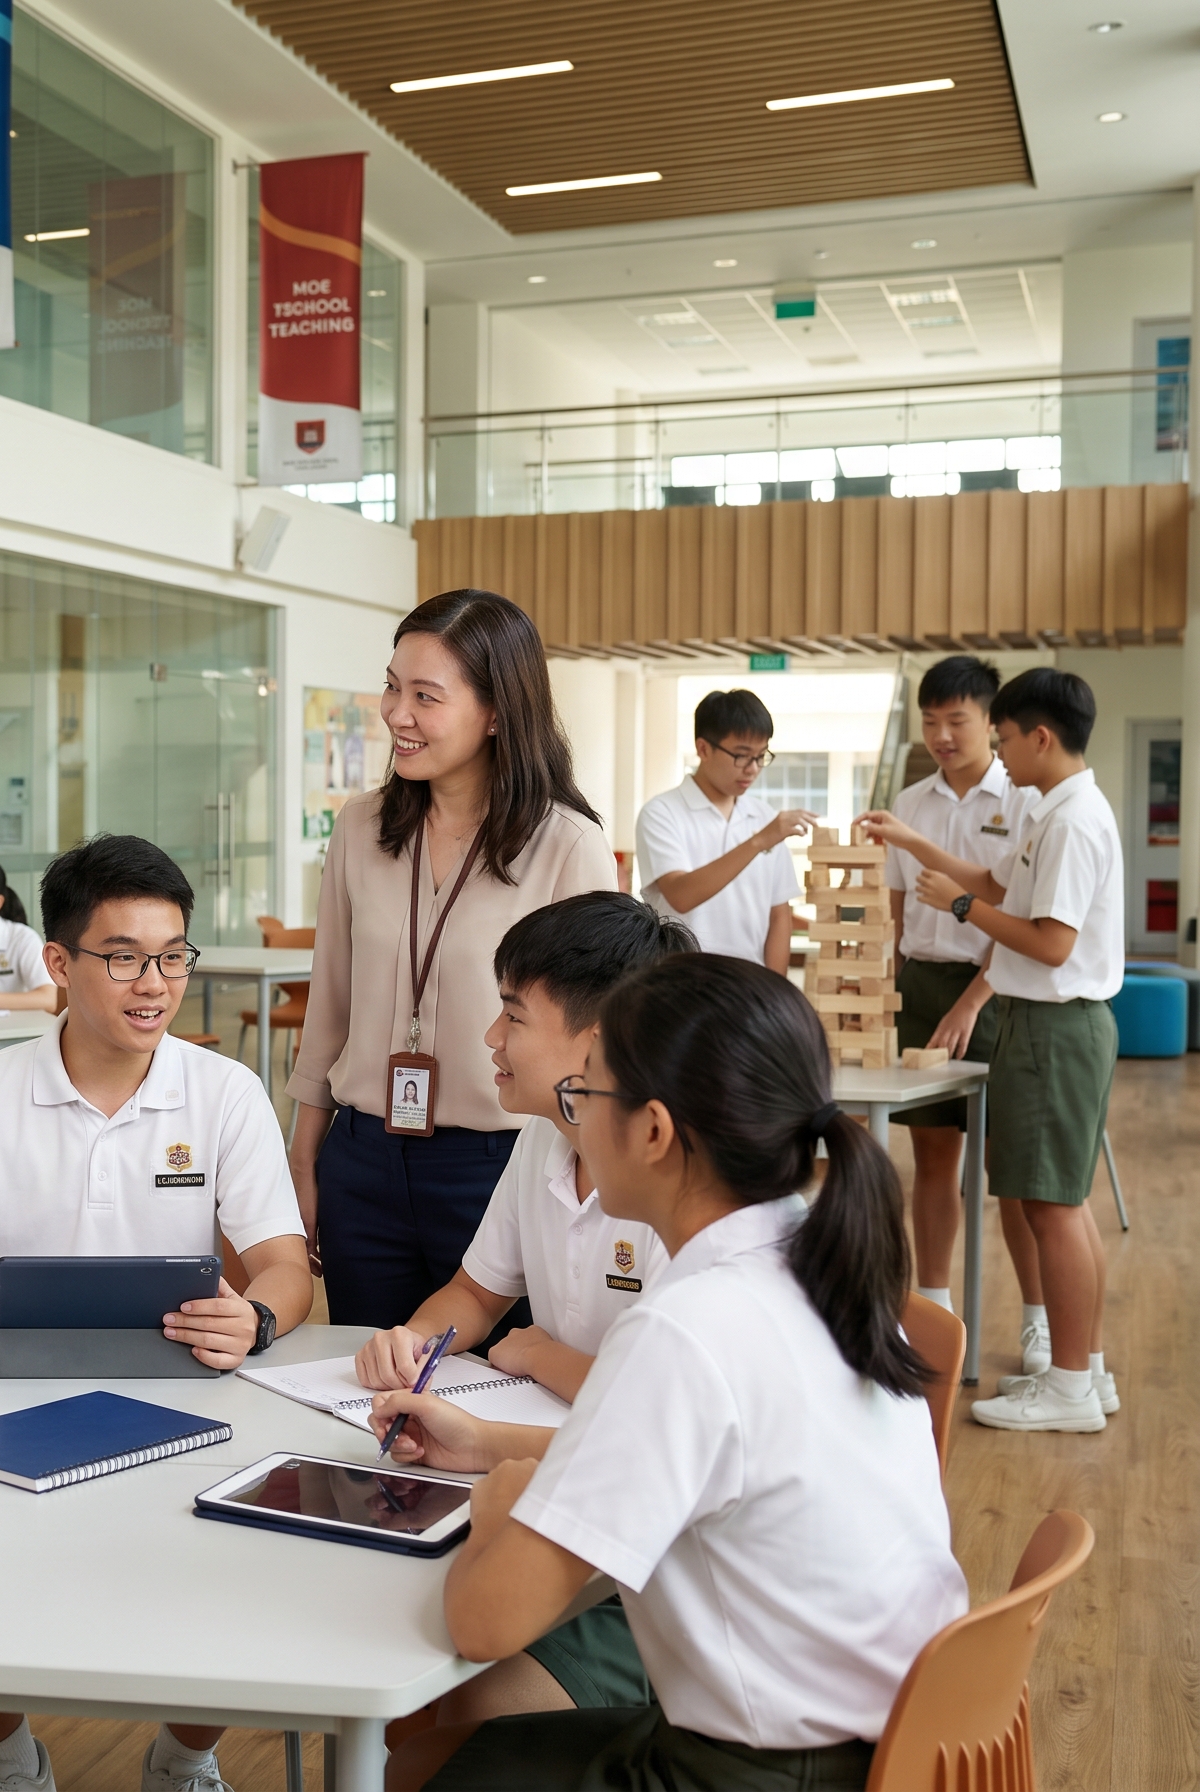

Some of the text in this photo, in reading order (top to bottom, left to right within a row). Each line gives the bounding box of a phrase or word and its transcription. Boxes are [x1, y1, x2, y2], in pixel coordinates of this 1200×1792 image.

[292, 278, 332, 297] MOE
[272, 297, 352, 318] TSCHOOL
[268, 316, 355, 339] TEACHING
